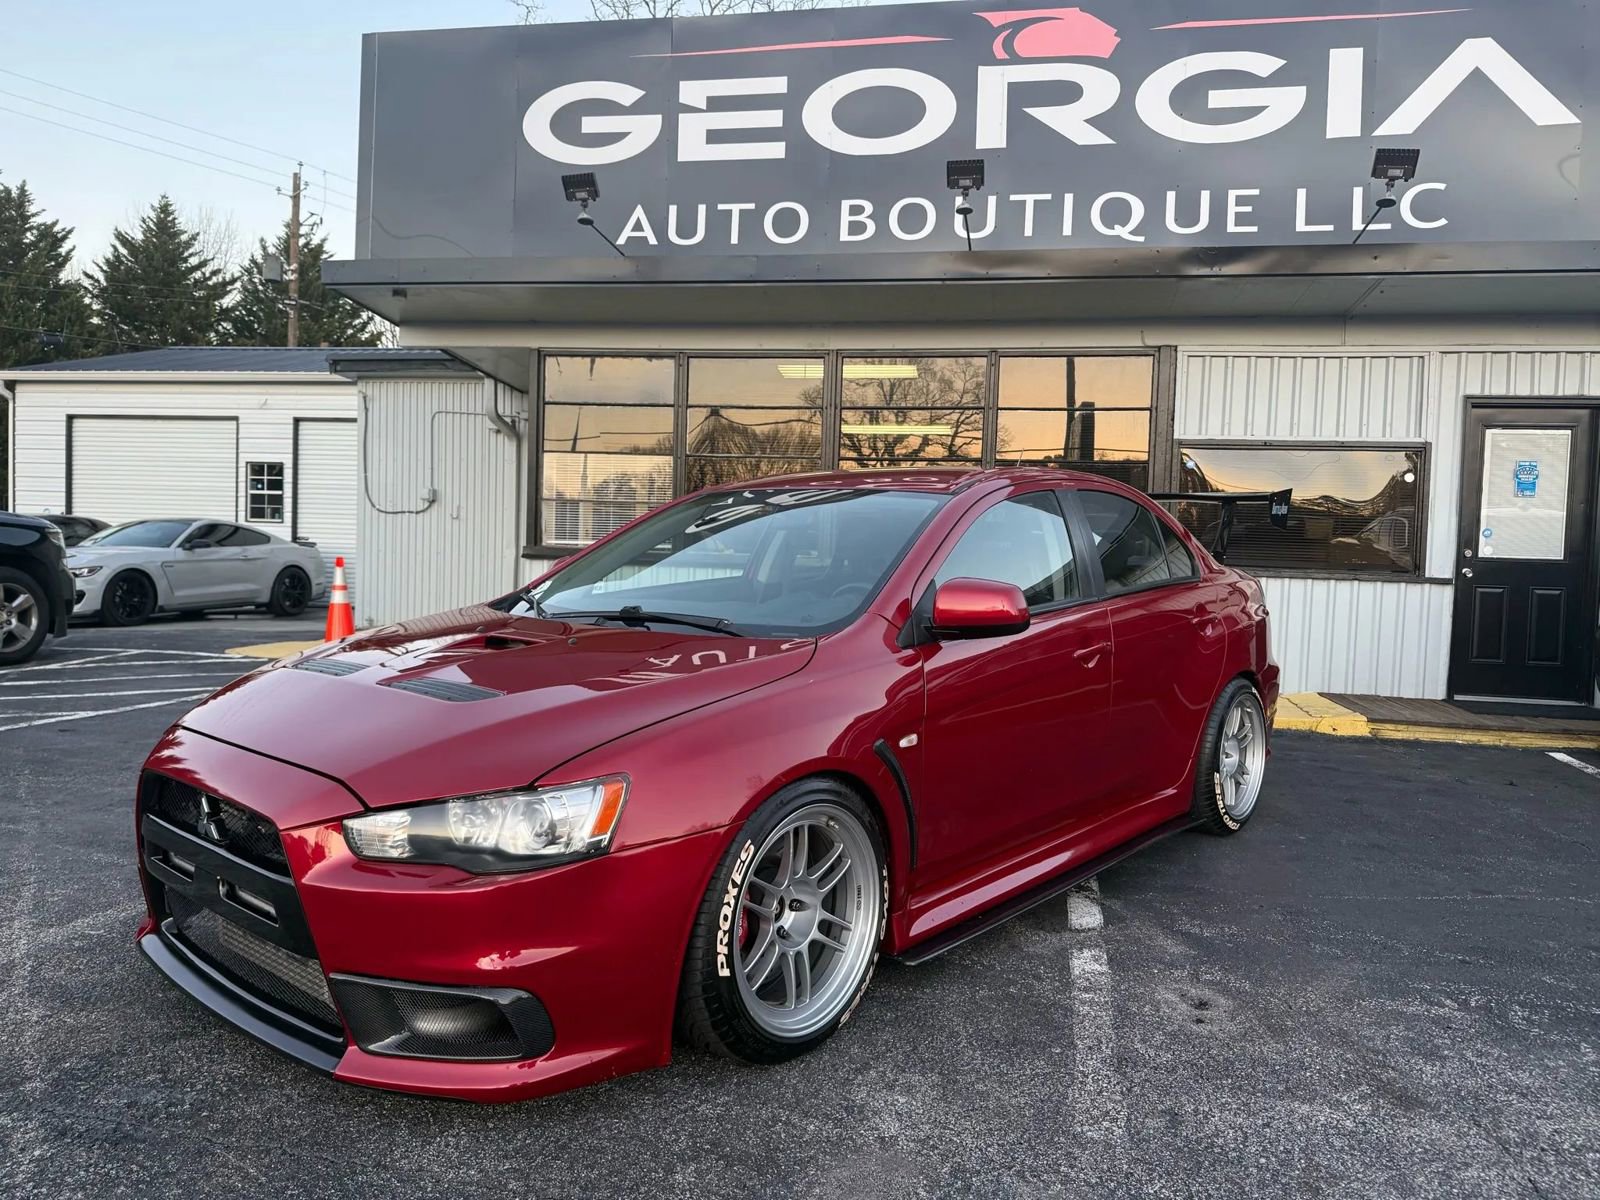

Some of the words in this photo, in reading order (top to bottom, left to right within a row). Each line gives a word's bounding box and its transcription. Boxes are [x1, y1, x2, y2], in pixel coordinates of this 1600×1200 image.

[522, 37, 1582, 166] GEORGIA
[615, 201, 809, 246] AUTO
[838, 188, 1260, 242] BOUTIQUE
[1295, 182, 1449, 232] LLC
[716, 839, 755, 977] PROXES
